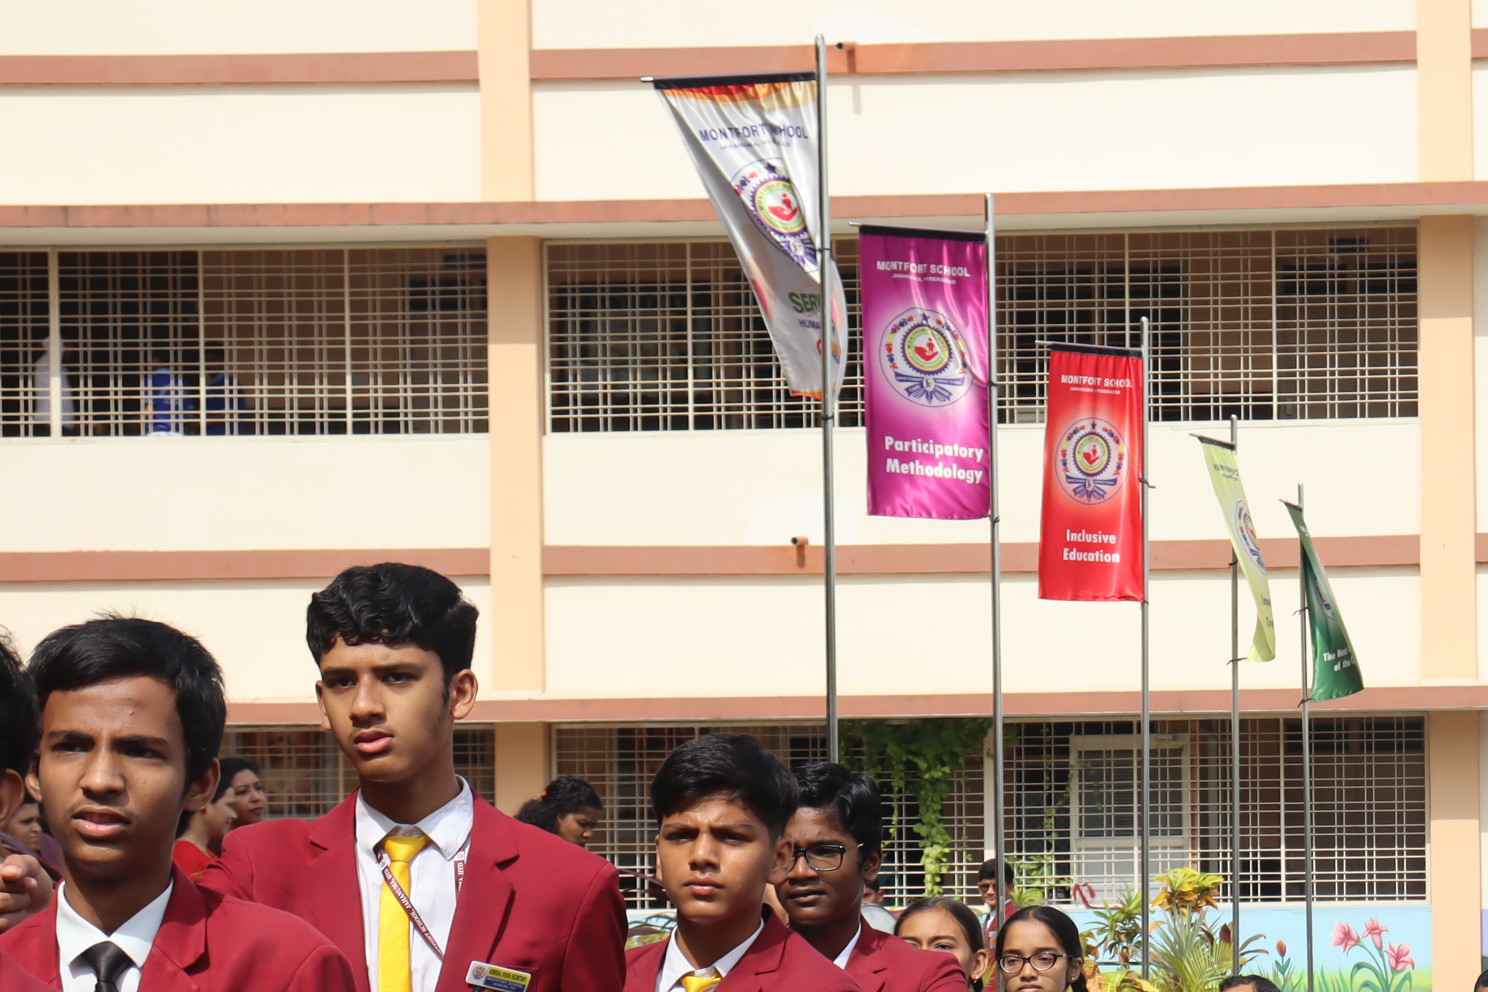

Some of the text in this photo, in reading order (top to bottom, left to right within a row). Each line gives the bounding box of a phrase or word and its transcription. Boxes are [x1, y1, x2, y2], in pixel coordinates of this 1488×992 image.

[877, 260, 971, 277] MONTFORT SCHOOL
[1061, 374, 1102, 386] MONTFORT
[884, 435, 984, 463] Participatory
[886, 458, 984, 484] Methodology
[1066, 529, 1116, 544] Inclusive
[1063, 547, 1120, 563] Education
